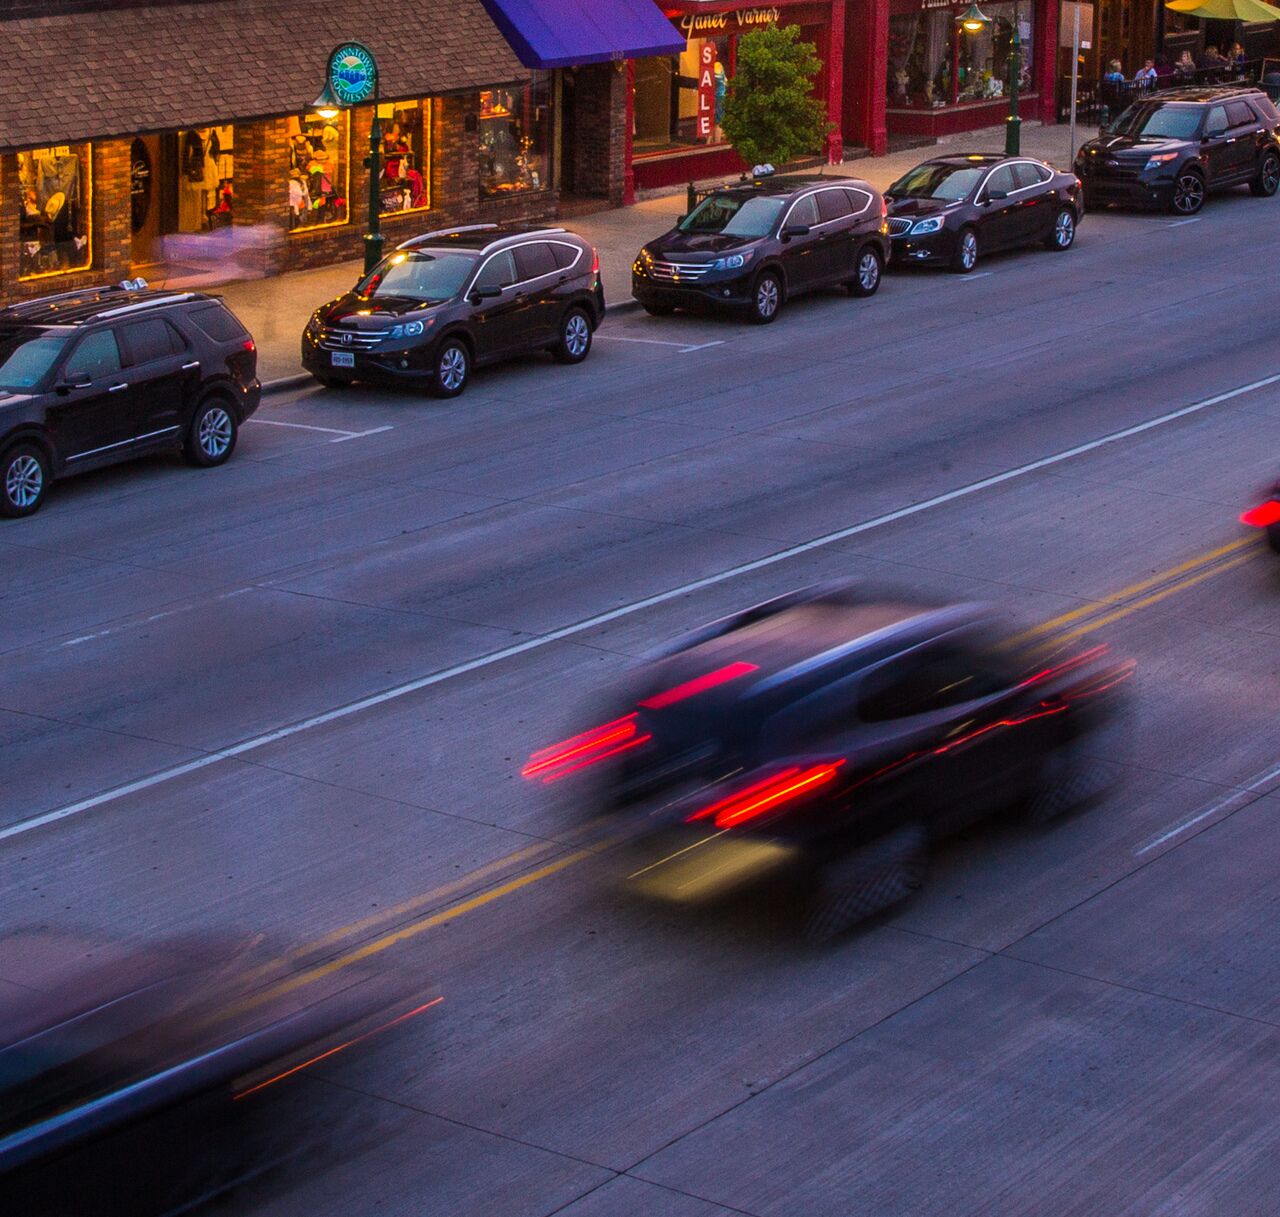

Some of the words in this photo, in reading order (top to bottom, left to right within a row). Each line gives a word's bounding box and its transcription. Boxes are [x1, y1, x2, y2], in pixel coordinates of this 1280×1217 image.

[681, 12, 728, 40] Janet
[736, 6, 780, 26] Varner
[332, 47, 373, 75] DOWNTOWN
[332, 75, 372, 102] ROCHESTER
[701, 46, 712, 134] SALE
